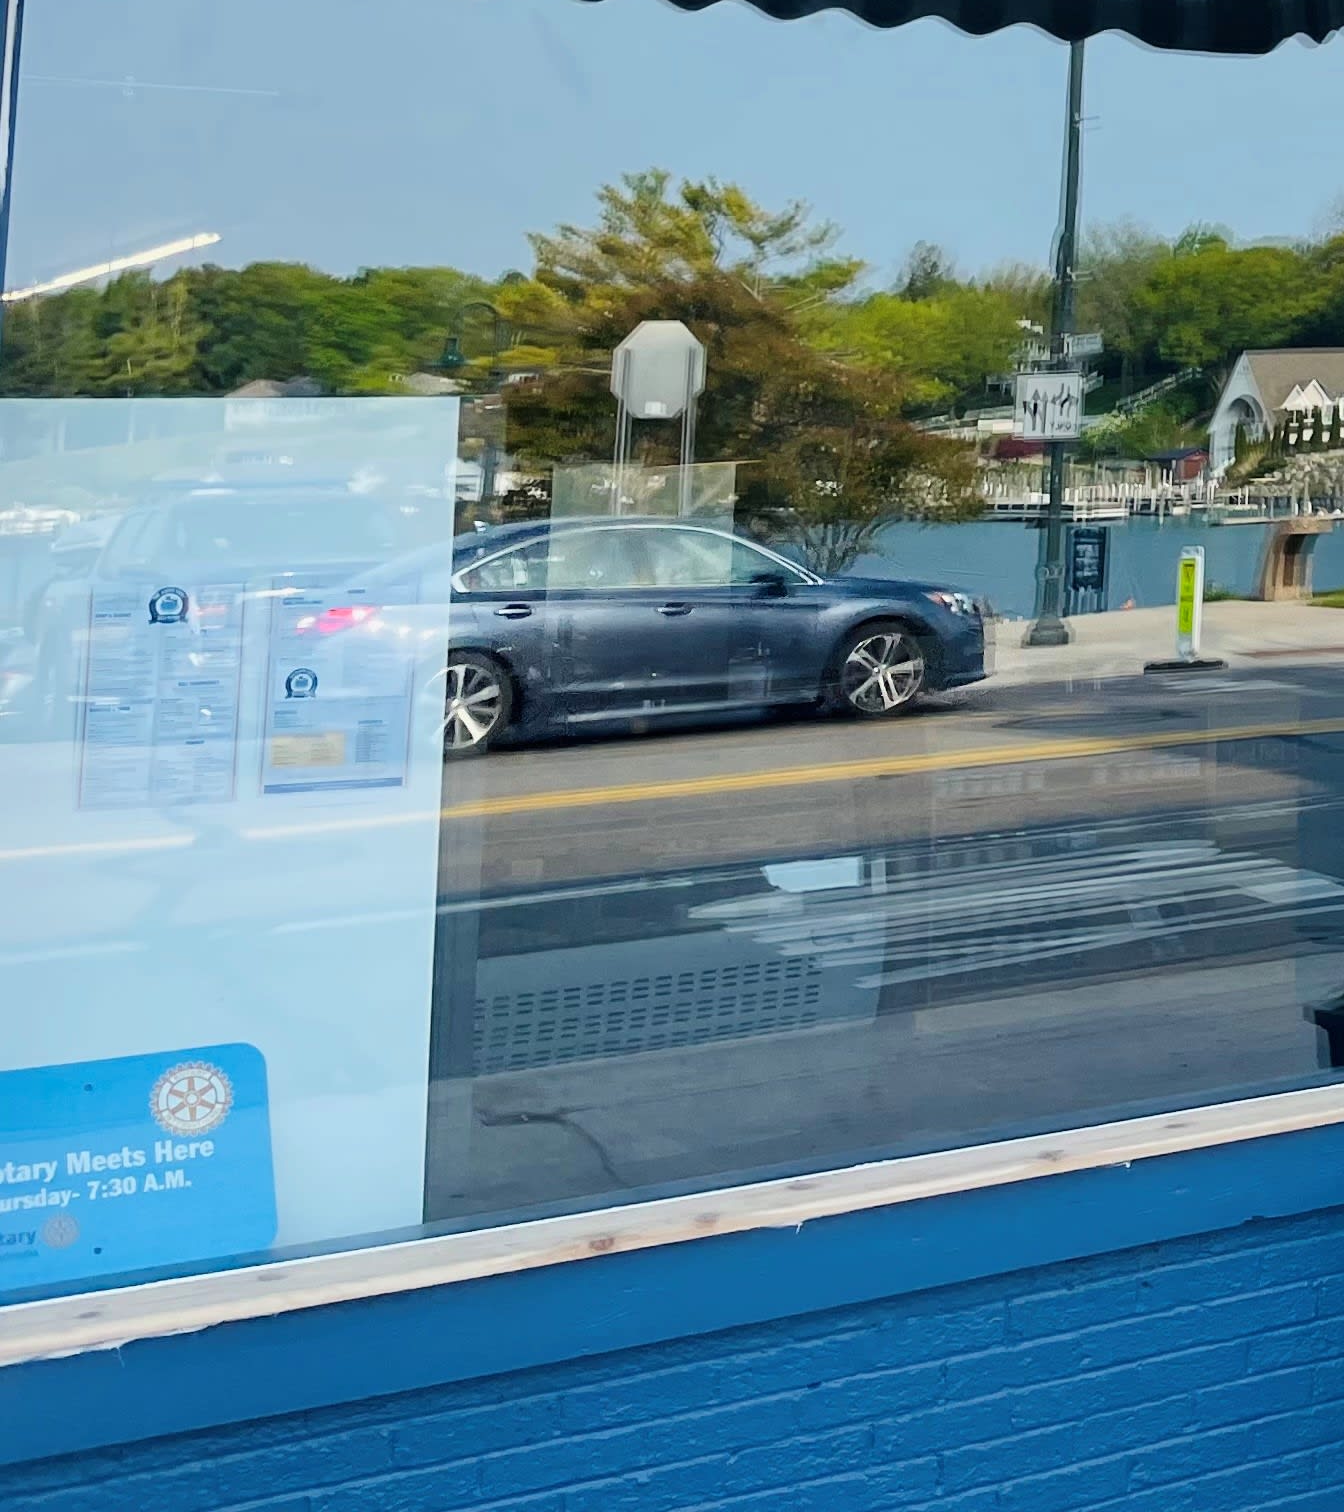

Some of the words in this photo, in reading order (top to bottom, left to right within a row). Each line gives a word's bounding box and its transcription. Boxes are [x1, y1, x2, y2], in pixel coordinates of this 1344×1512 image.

[67, 1146, 146, 1175] Meets
[154, 1140, 215, 1164] Here
[87, 1176, 137, 1201] 7:30
[143, 1169, 192, 1193] A.M.
